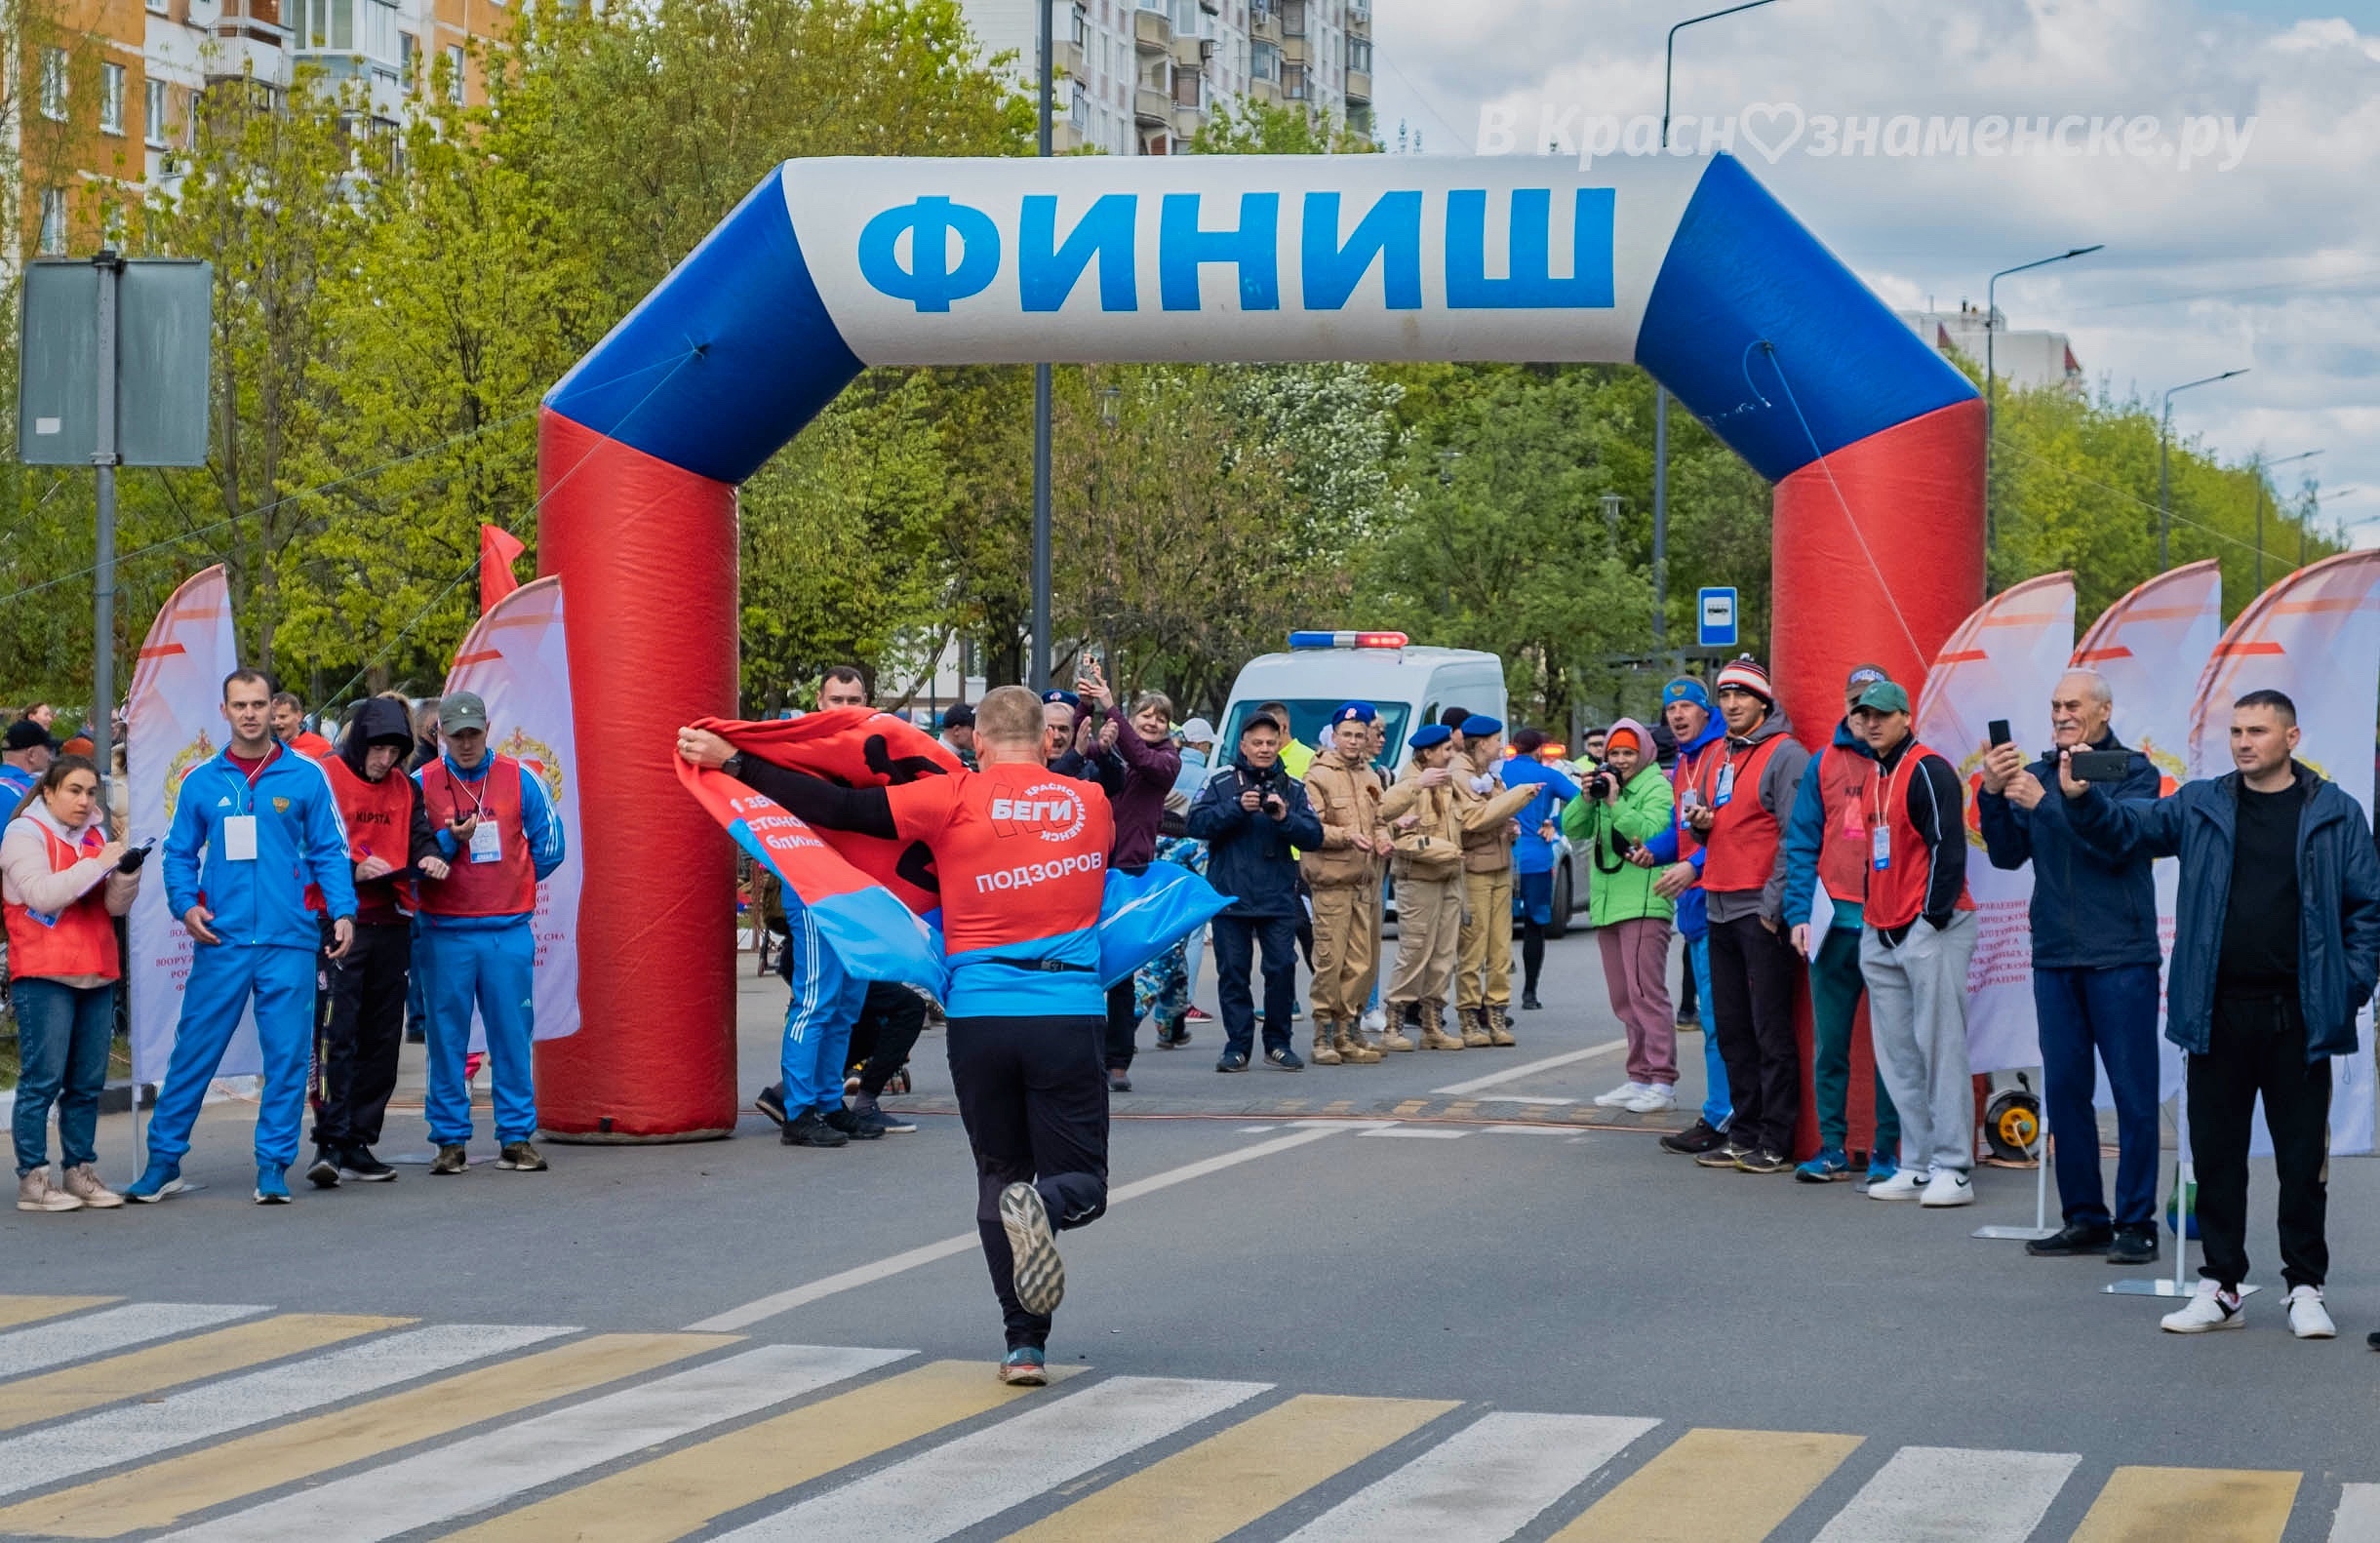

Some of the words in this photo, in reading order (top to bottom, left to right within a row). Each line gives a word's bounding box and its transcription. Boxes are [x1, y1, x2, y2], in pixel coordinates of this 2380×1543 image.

[857, 187, 1615, 312] ФИНИШ
[355, 811, 391, 825] KIPSTA
[991, 799, 1072, 821] БЕГИ
[1024, 782, 1086, 842] КРАСНОЗНАМЕНСК
[975, 851, 1102, 893] ПОДЗОРОВ
